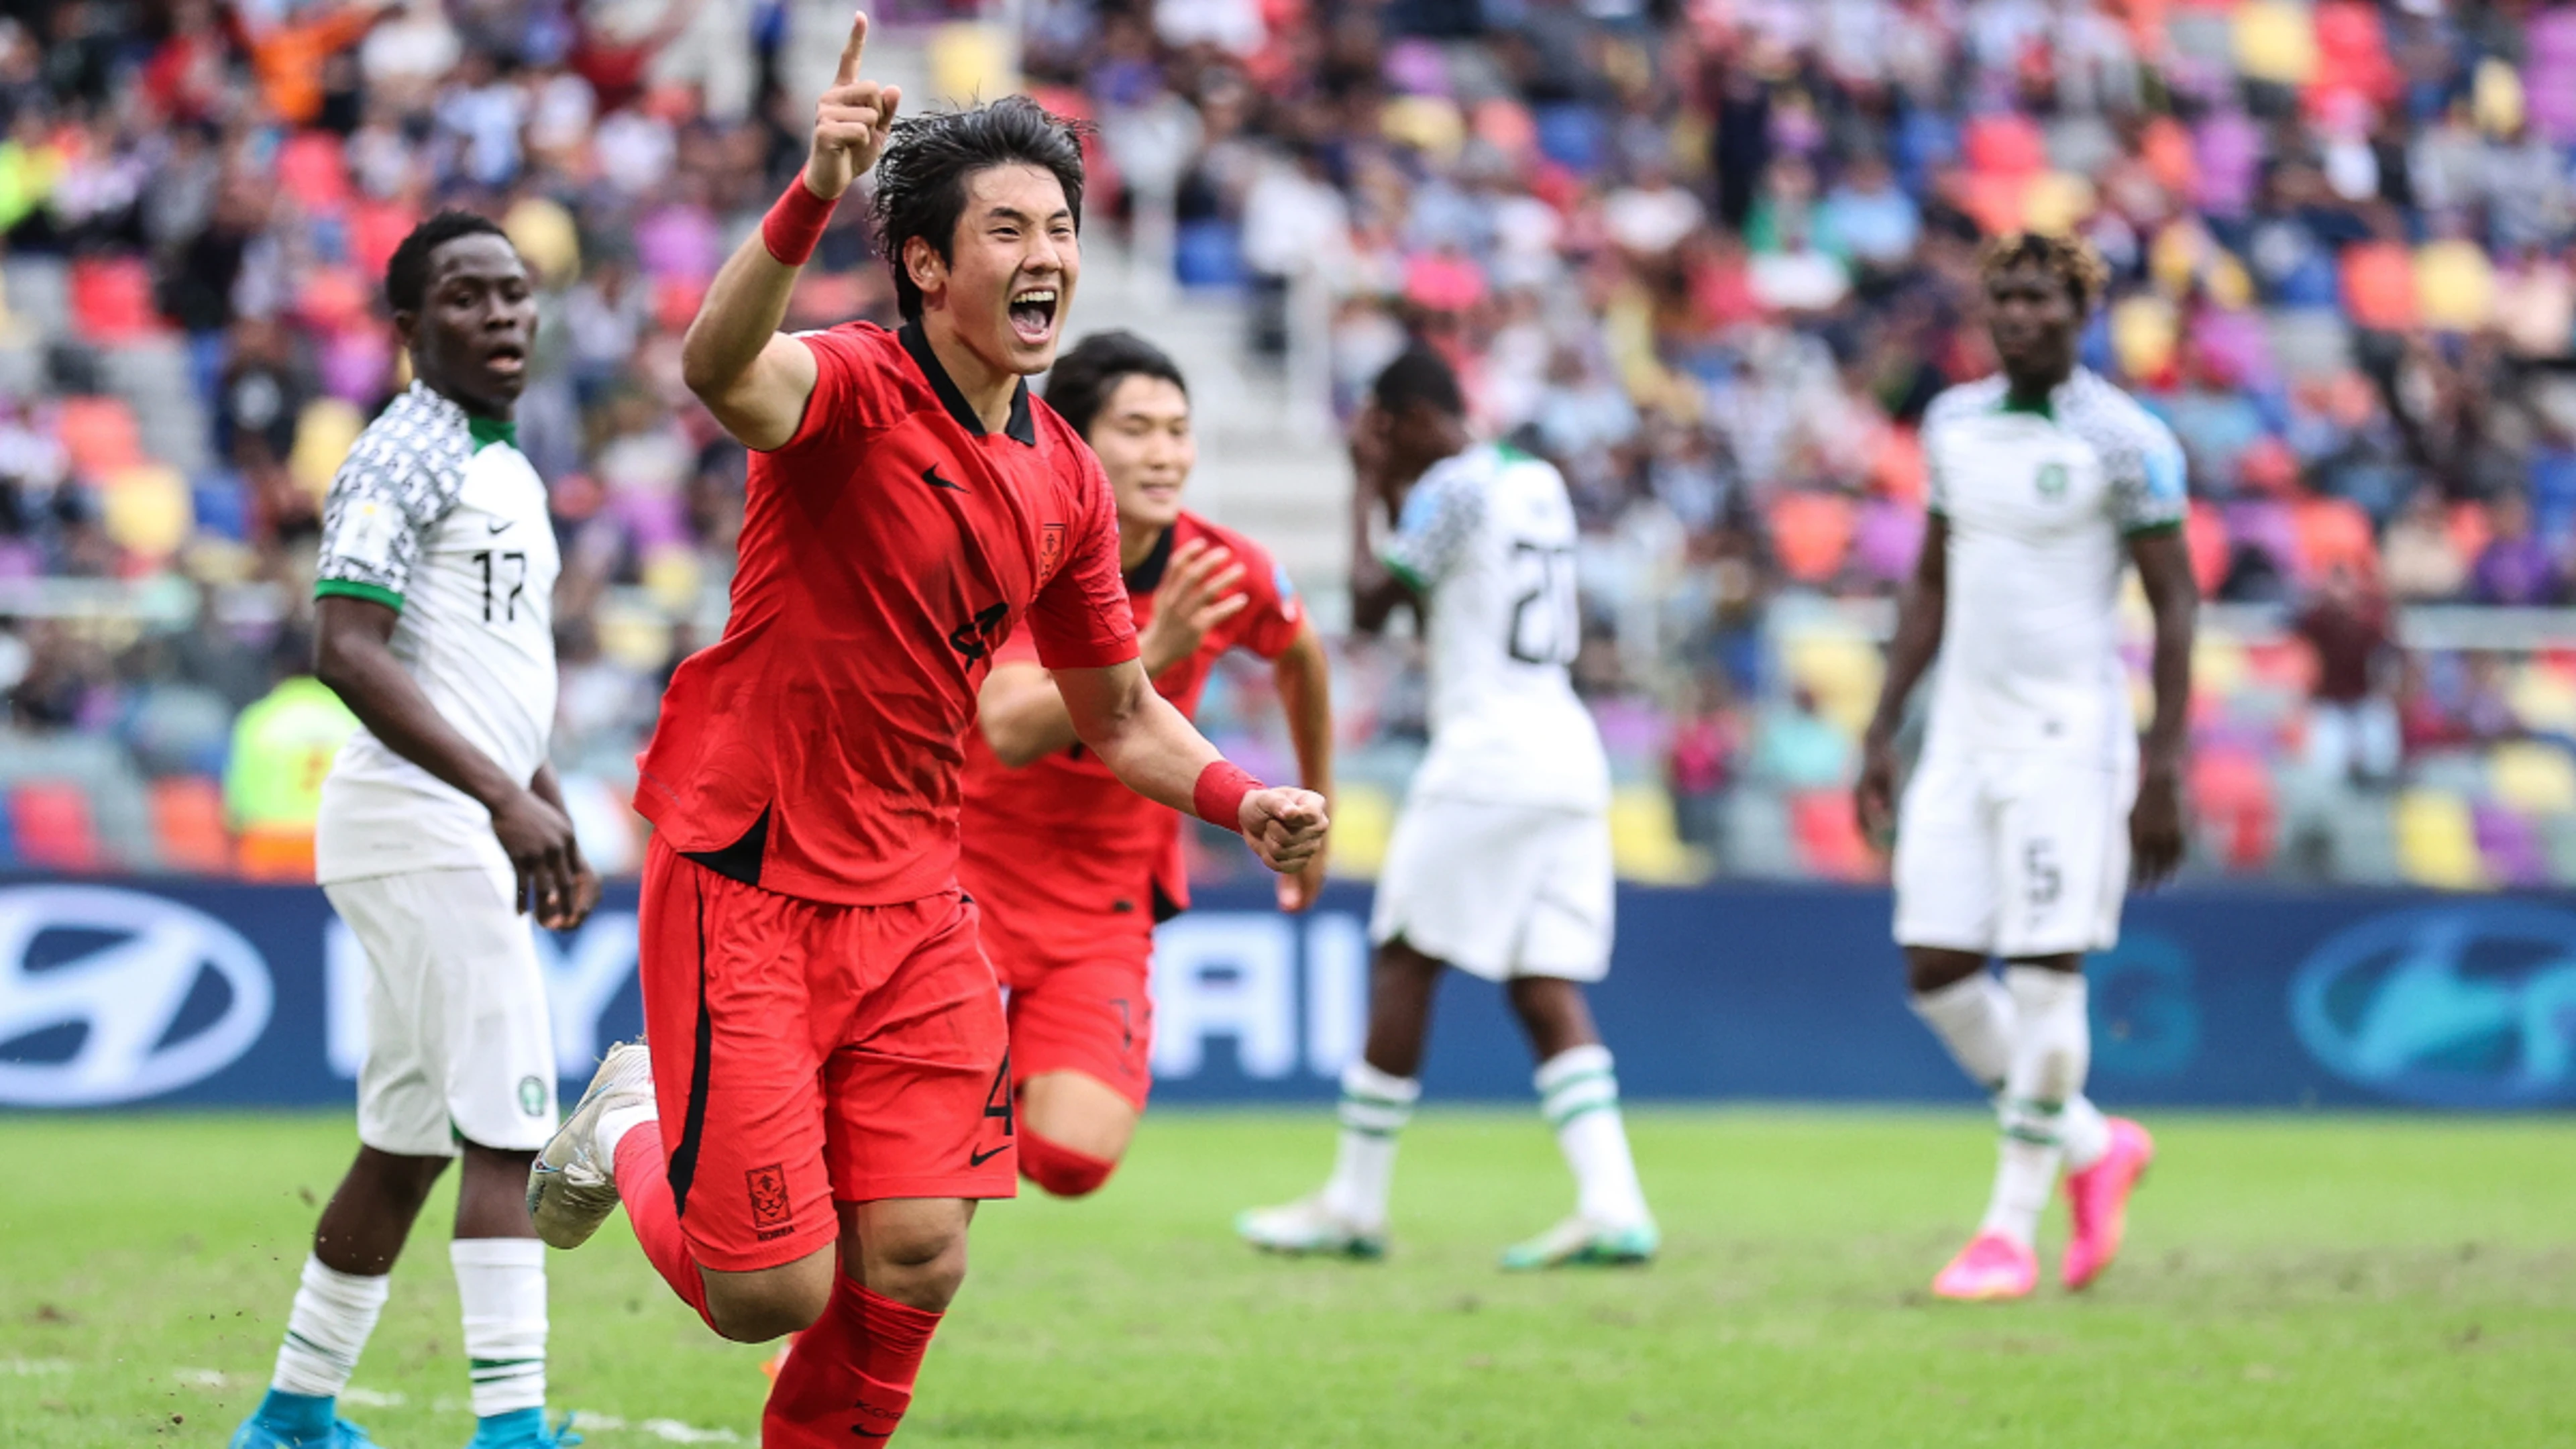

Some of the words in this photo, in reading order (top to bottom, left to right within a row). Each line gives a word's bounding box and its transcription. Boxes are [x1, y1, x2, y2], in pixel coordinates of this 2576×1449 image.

[472, 551, 528, 623] 17
[949, 601, 1009, 674] 4
[2024, 837, 2062, 905] 5
[984, 1045, 1014, 1136] 4
[757, 1225, 796, 1242] KOREA
